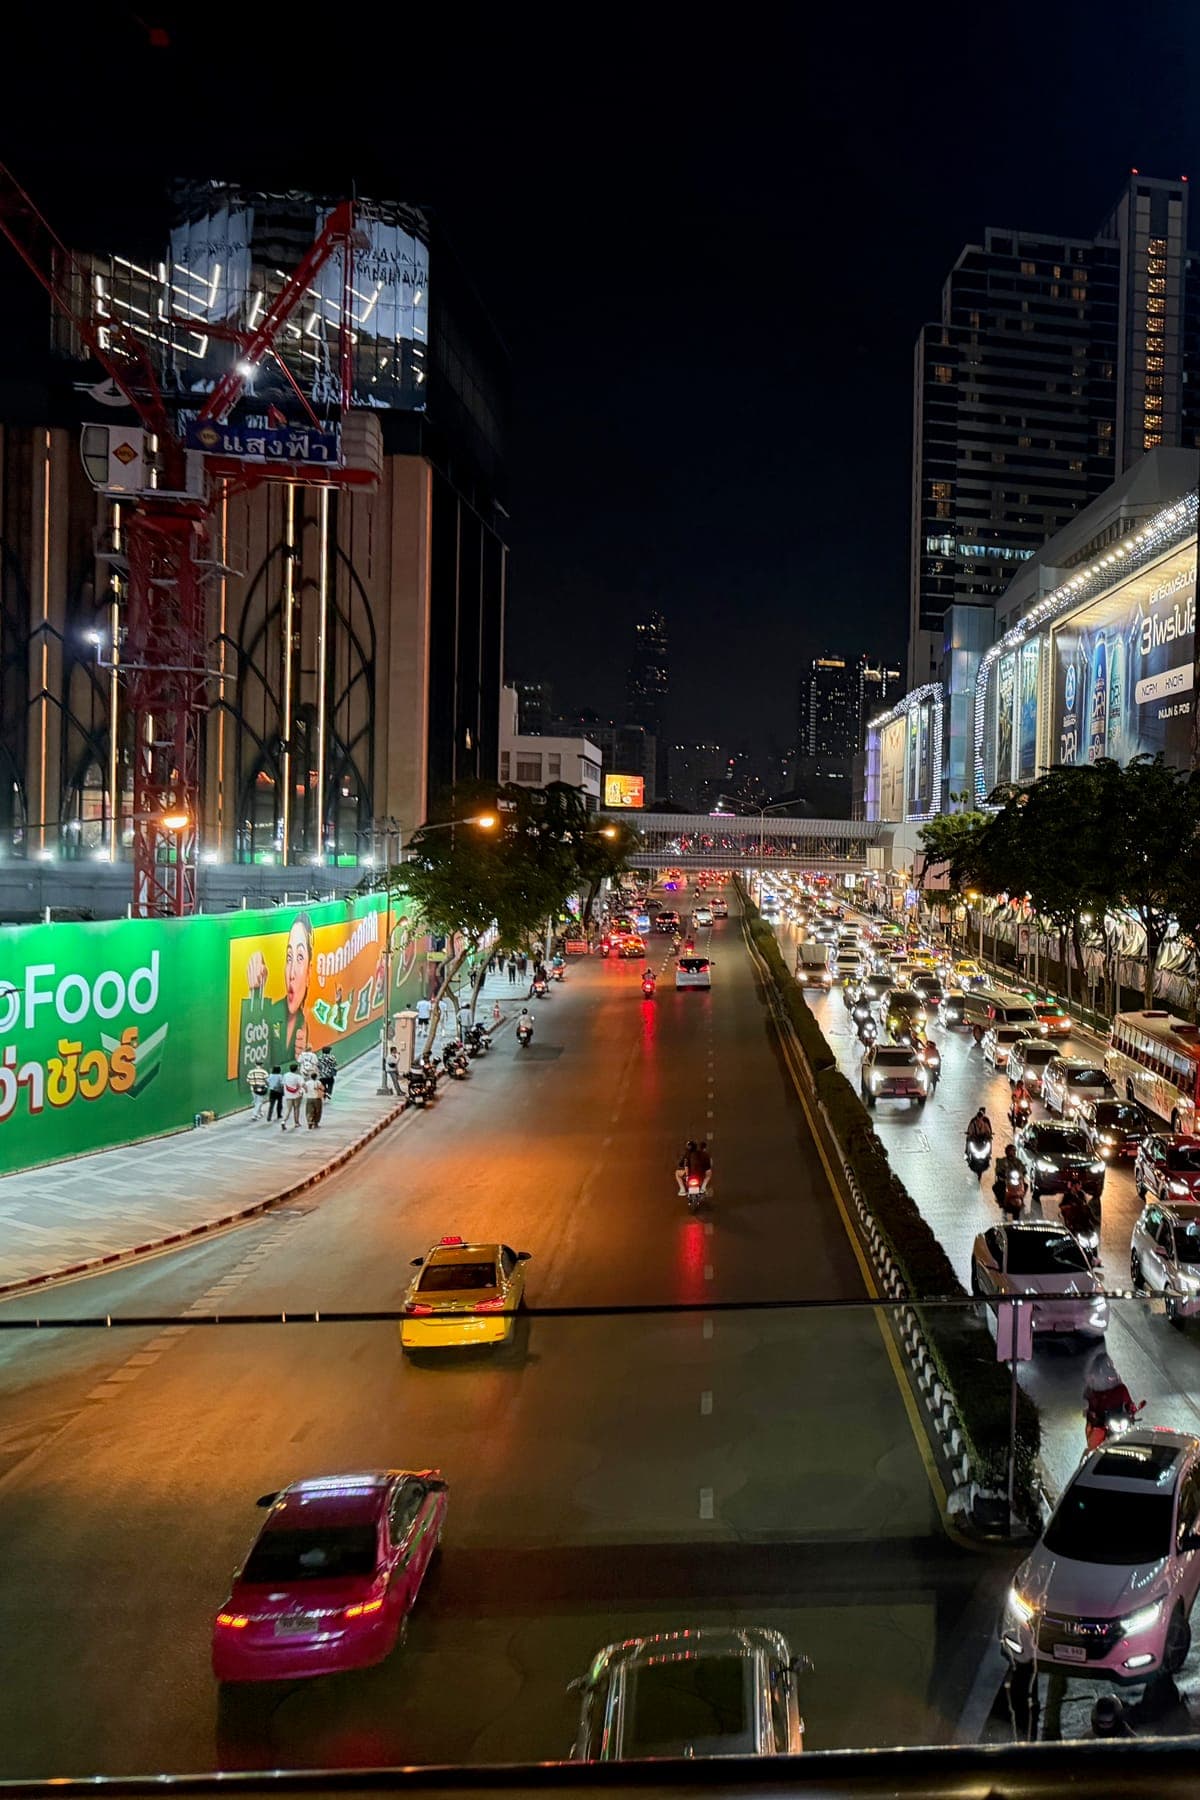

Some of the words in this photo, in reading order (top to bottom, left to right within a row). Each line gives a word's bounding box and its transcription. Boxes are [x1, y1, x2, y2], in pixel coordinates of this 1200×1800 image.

[223, 431, 329, 460] แสงฟ้า
[244, 1021, 269, 1042] Grab
[244, 1044, 269, 1065] Food
